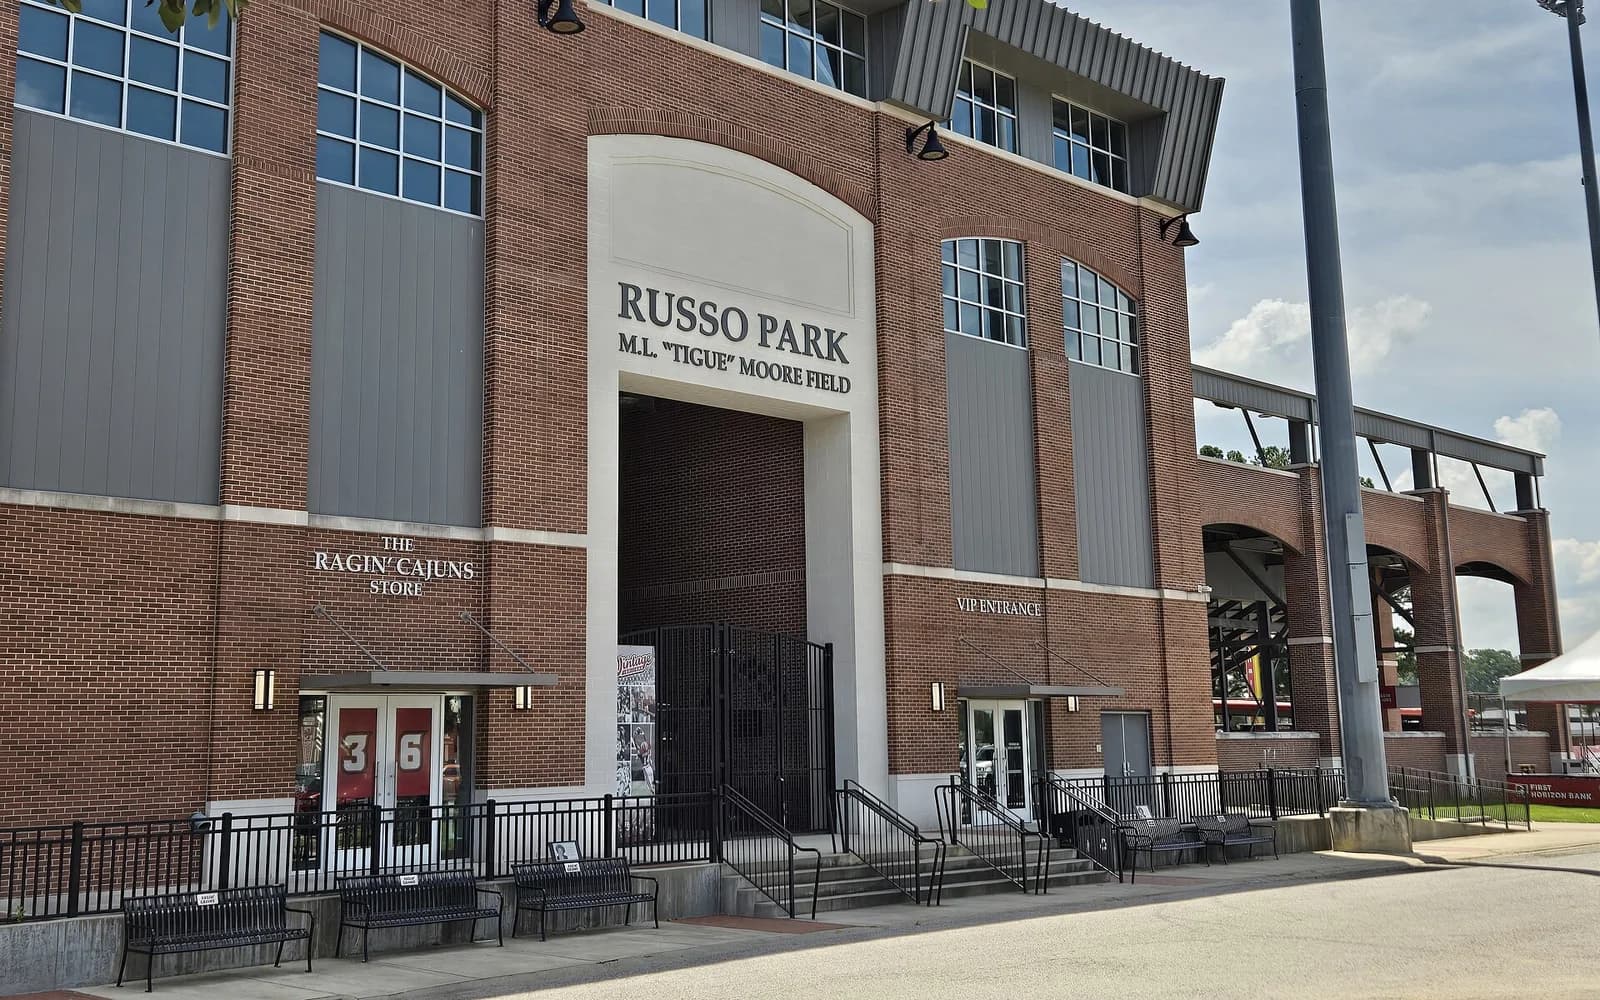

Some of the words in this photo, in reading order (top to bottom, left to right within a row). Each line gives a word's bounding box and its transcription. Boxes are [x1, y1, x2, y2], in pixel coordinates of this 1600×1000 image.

[618, 281, 749, 342] RUSSO
[757, 313, 850, 364] PARK
[618, 332, 658, 359] M.L.
[662, 341, 735, 371] "TIGUE"
[739, 356, 802, 385] MOORE
[806, 369, 851, 394] FIELD
[382, 536, 414, 551] THE
[314, 552, 392, 575] RAGIN'
[396, 557, 474, 581] CAJUNS
[370, 580, 422, 596] STORE
[957, 597, 977, 612] VIP
[980, 599, 1041, 617] ENTRANCE
[342, 733, 369, 772] 3
[400, 733, 424, 770] 6
[1530, 783, 1552, 791] FIRST
[1531, 791, 1567, 799] HORIZON
[1568, 792, 1592, 800] BANK
